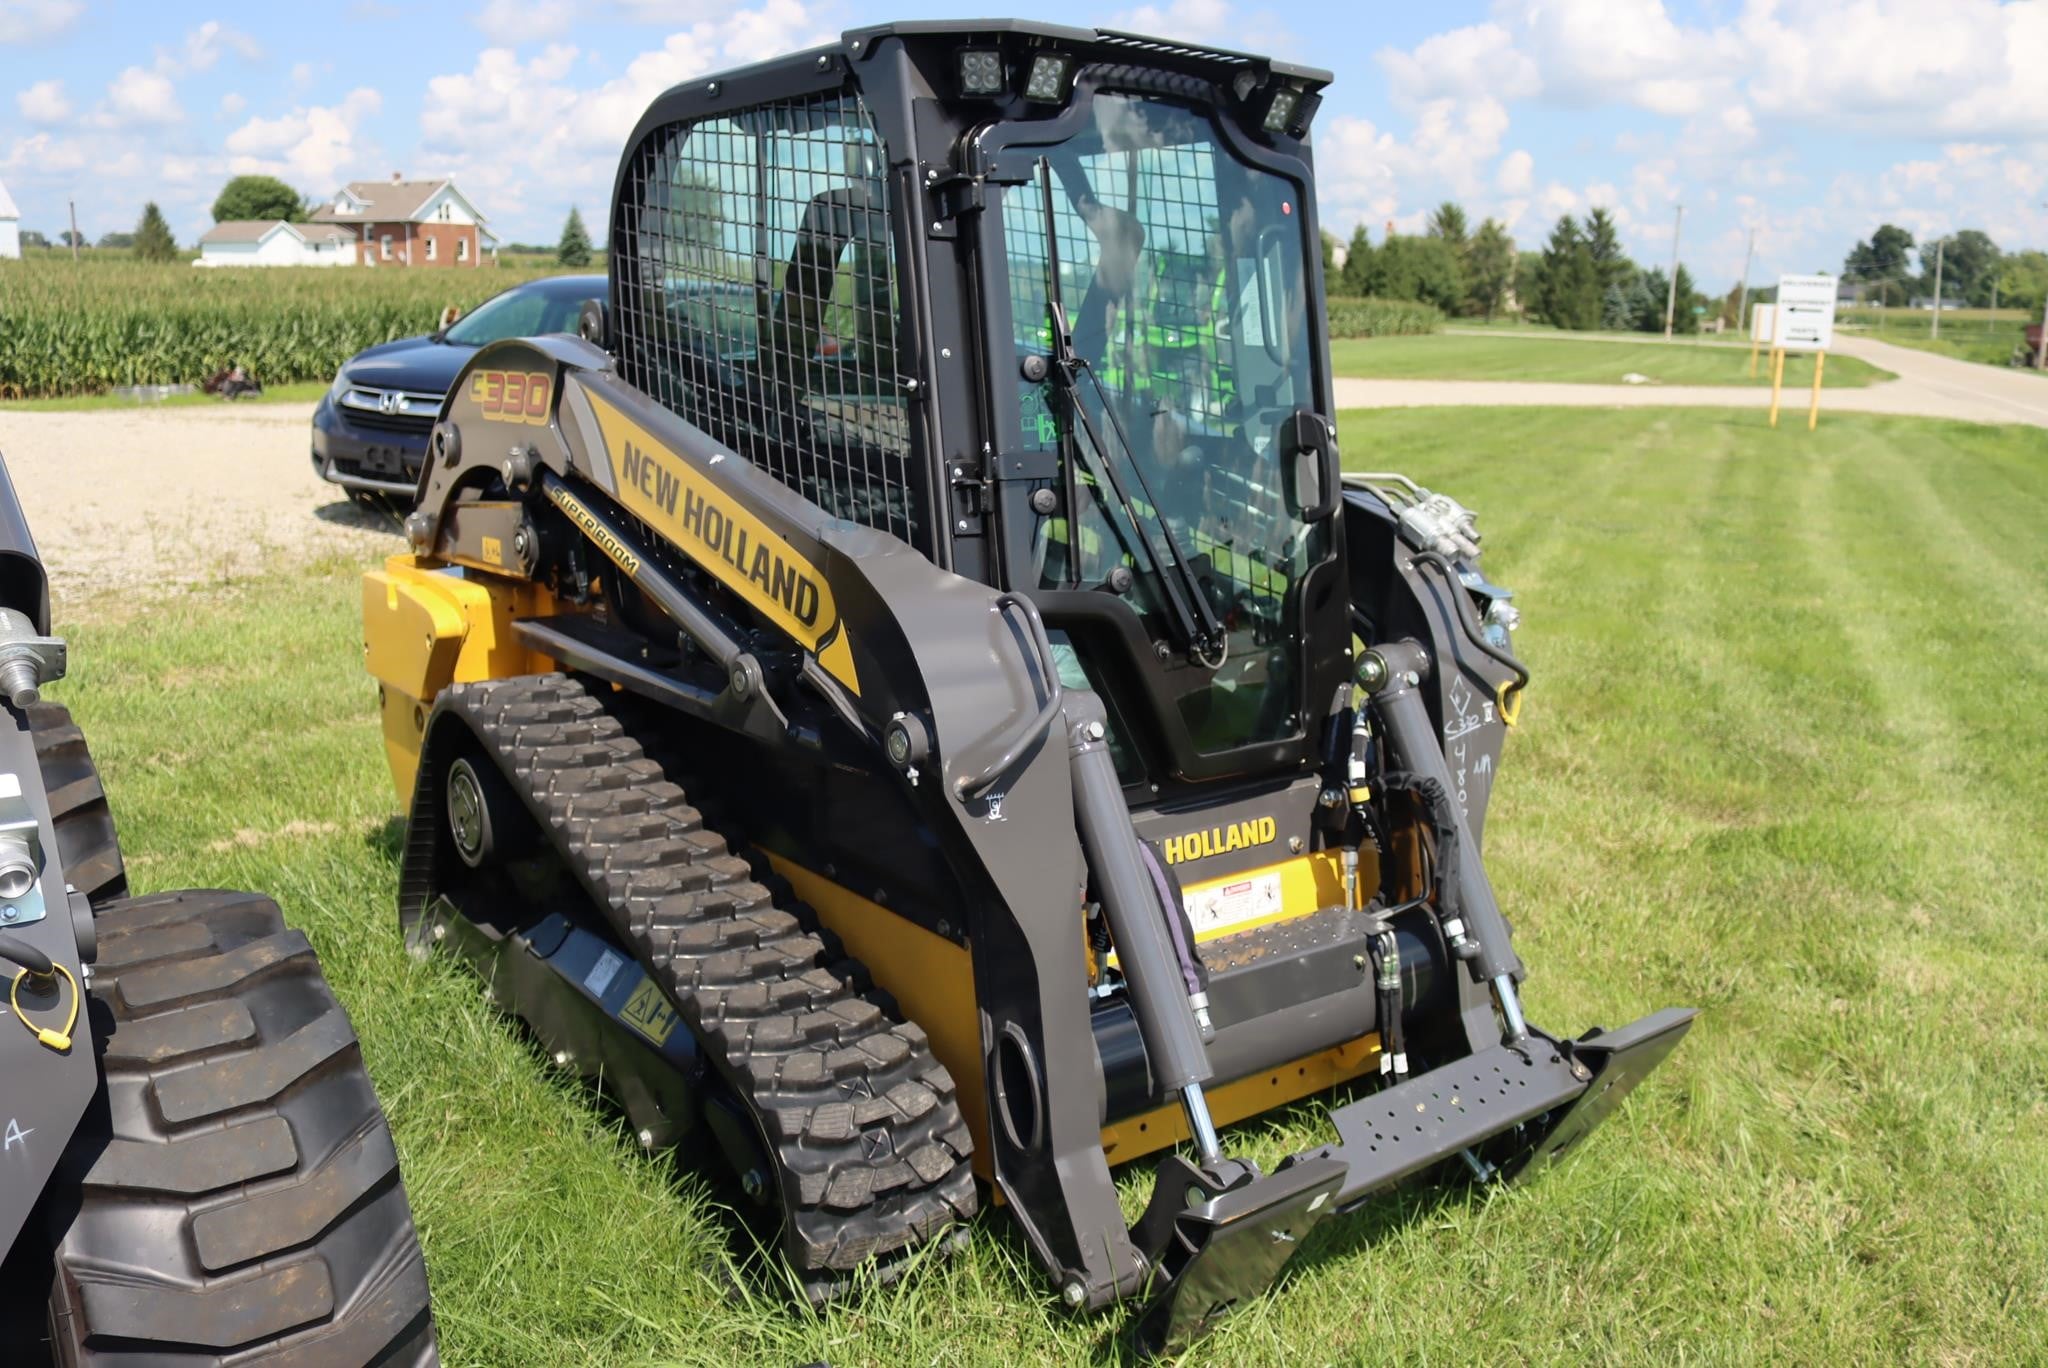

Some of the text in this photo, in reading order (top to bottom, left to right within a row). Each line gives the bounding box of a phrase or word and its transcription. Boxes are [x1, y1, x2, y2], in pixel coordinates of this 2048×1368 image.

[622, 440, 819, 628] NEW HOLLAND
[1164, 815, 1276, 865] HOLLAND
[4, 1117, 37, 1151] A
